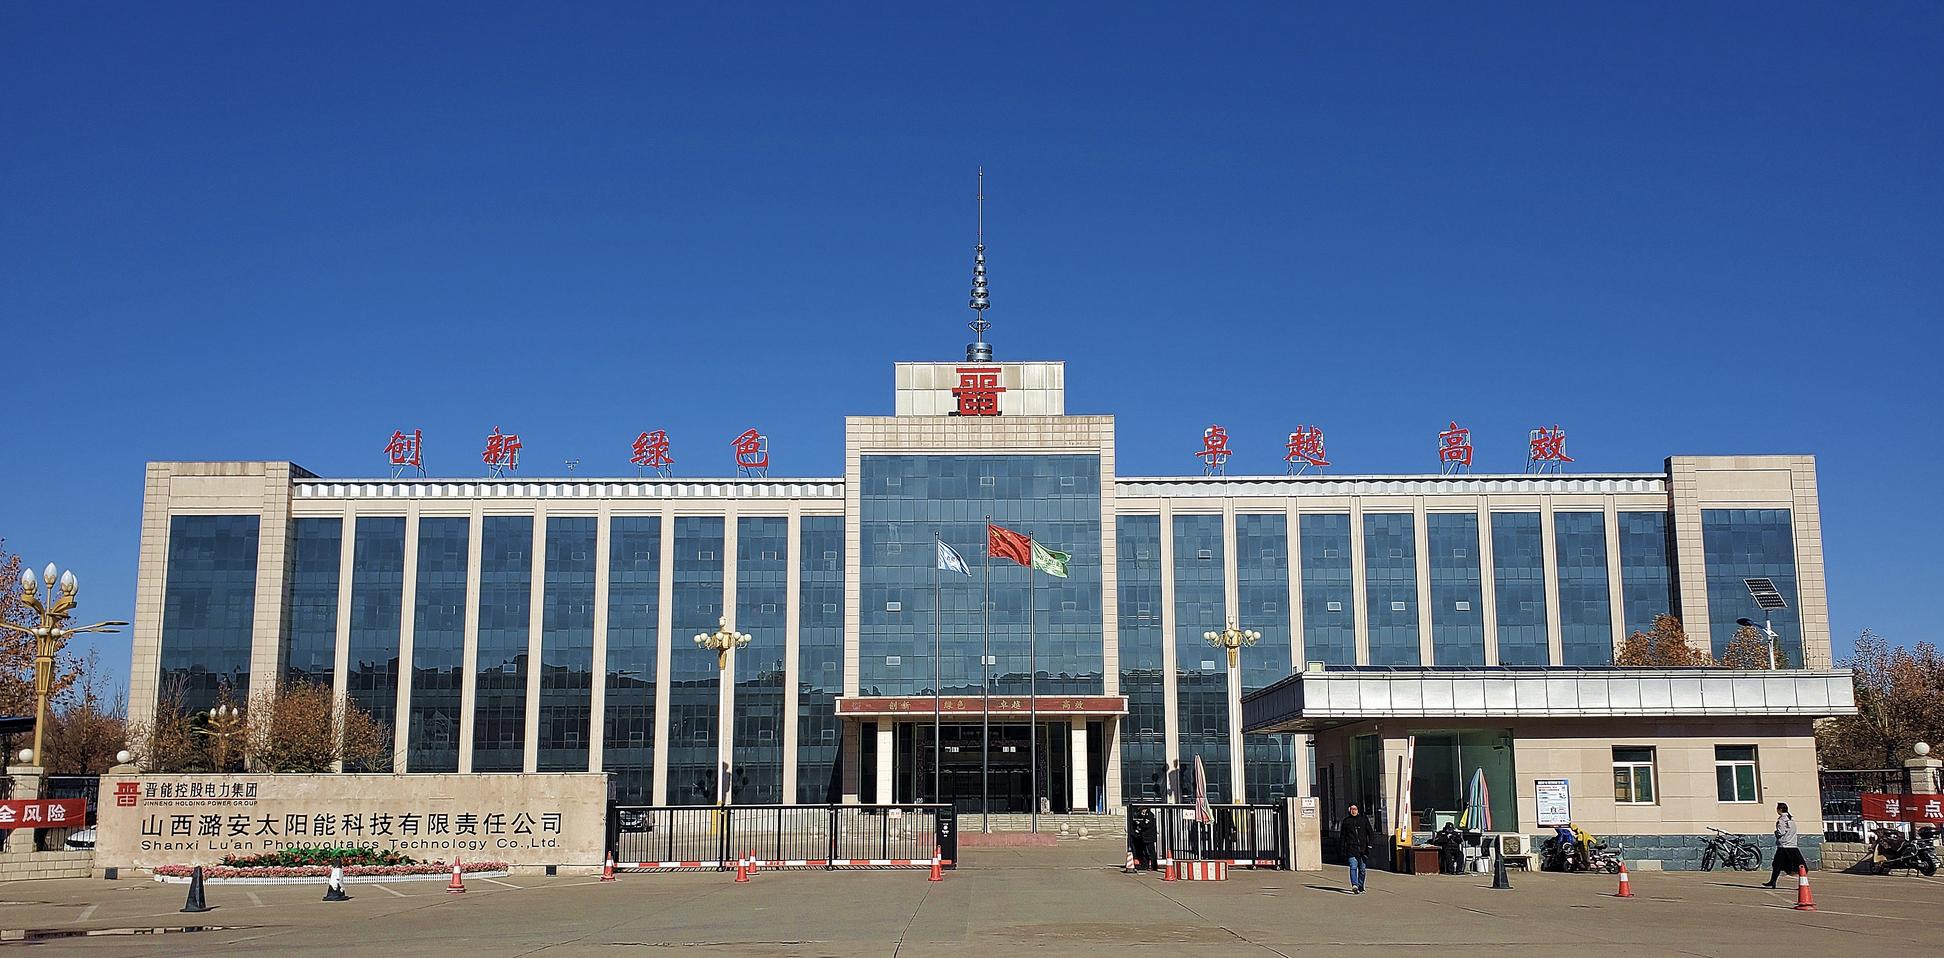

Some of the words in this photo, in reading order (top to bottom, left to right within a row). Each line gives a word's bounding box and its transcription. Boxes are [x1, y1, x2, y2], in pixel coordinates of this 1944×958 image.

[384, 426, 522, 470] 创新
[630, 427, 769, 468] 绿色
[1195, 424, 1332, 468] 卓越
[1439, 421, 1575, 466] 高效
[145, 782, 258, 798] 晋能控股电力集团
[0, 804, 66, 822] 全风险
[1885, 799, 1944, 818] 学一点
[141, 812, 562, 837] 山西潞安太阳能科技有限责任公司
[141, 840, 199, 850] Shanxi
[209, 839, 253, 850] Lu'an
[263, 839, 379, 850] Photovoltaics
[389, 838, 487, 850] Technology
